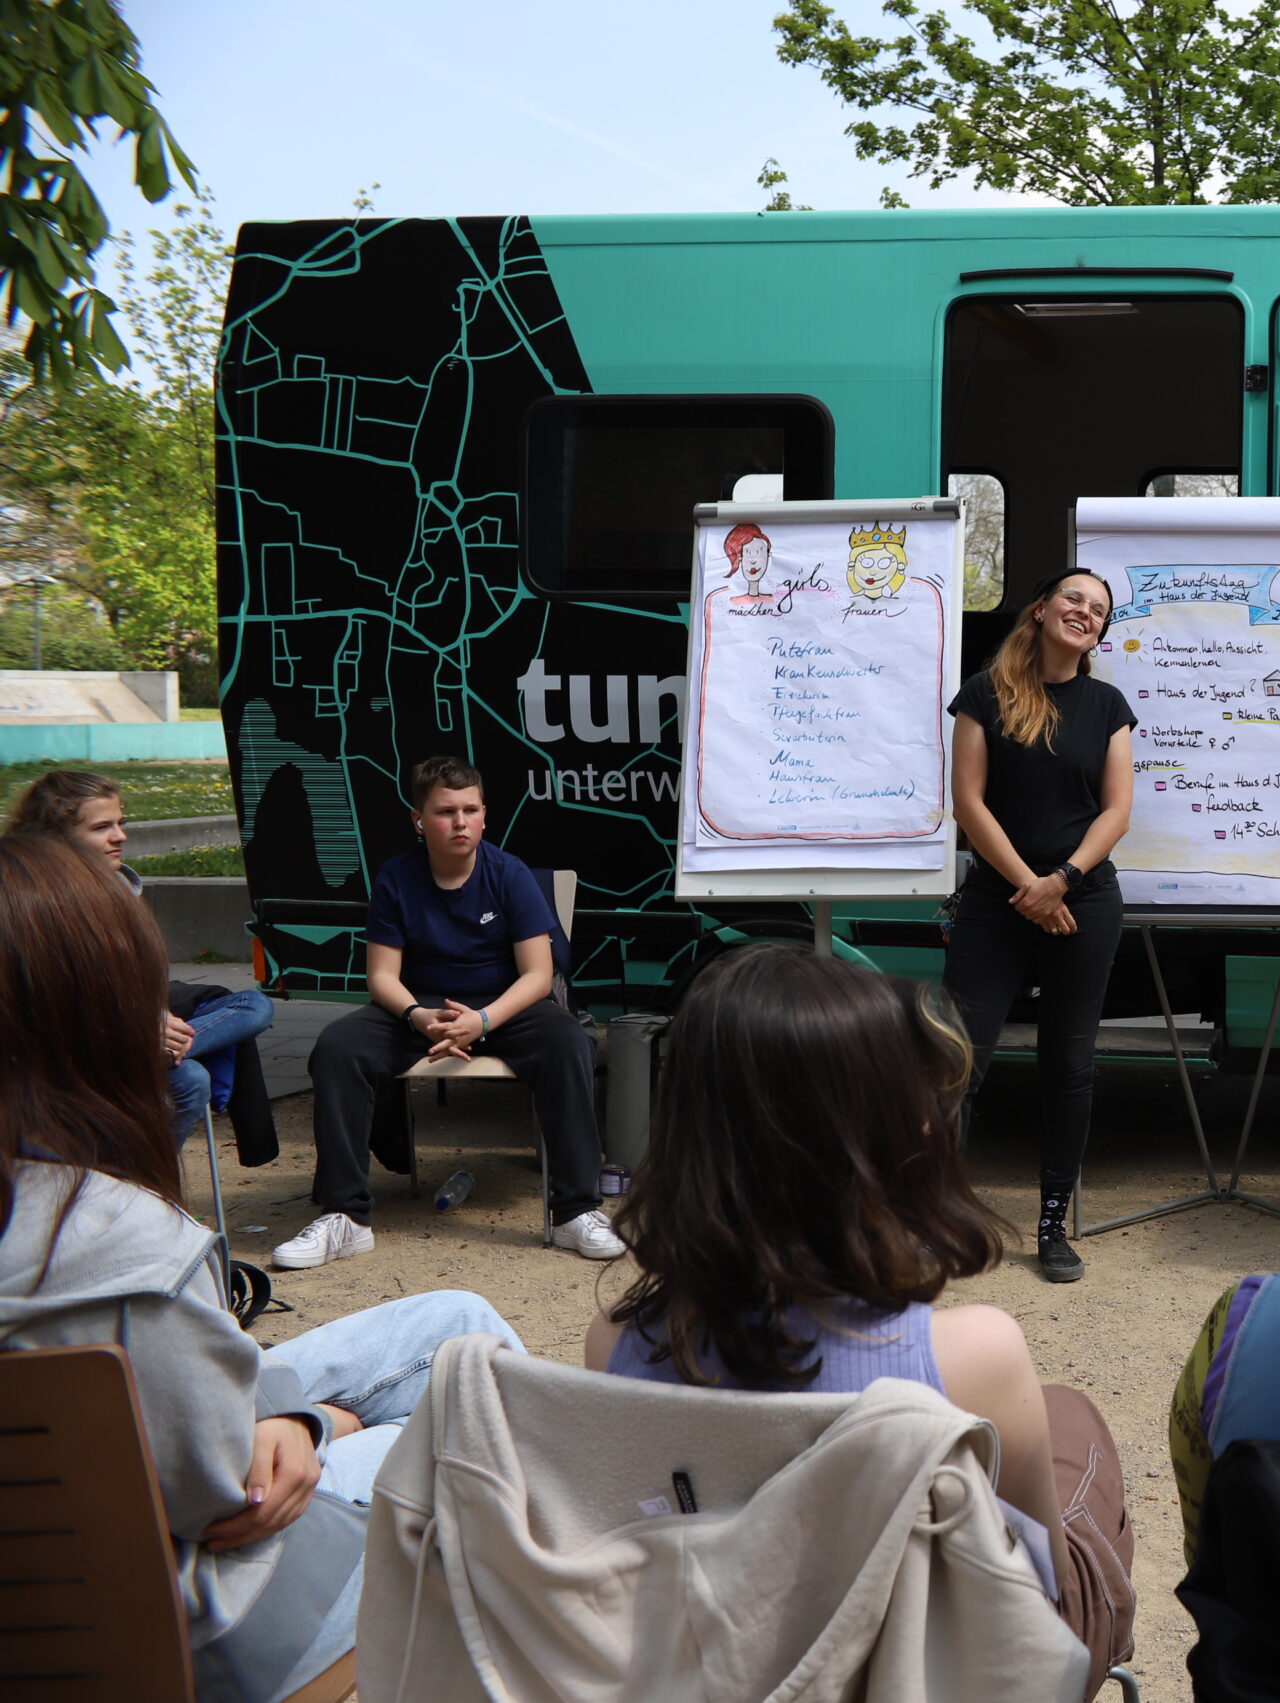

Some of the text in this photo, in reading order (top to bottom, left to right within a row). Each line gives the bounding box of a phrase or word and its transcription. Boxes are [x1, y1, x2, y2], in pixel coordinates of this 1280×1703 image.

[1160, 591, 1186, 601] Haus
[1191, 590, 1208, 600] der
[1211, 589, 1251, 602] Jugend
[842, 601, 909, 624] frauen
[767, 637, 836, 659] Putzfrau
[1157, 680, 1187, 698] Haus
[1192, 683, 1208, 698] der
[1133, 759, 1185, 773] gspause
[527, 763, 683, 803] unterw
[1170, 772, 1216, 795] Berufe
[1234, 775, 1260, 788] Haus
[1206, 794, 1264, 814] feedback
